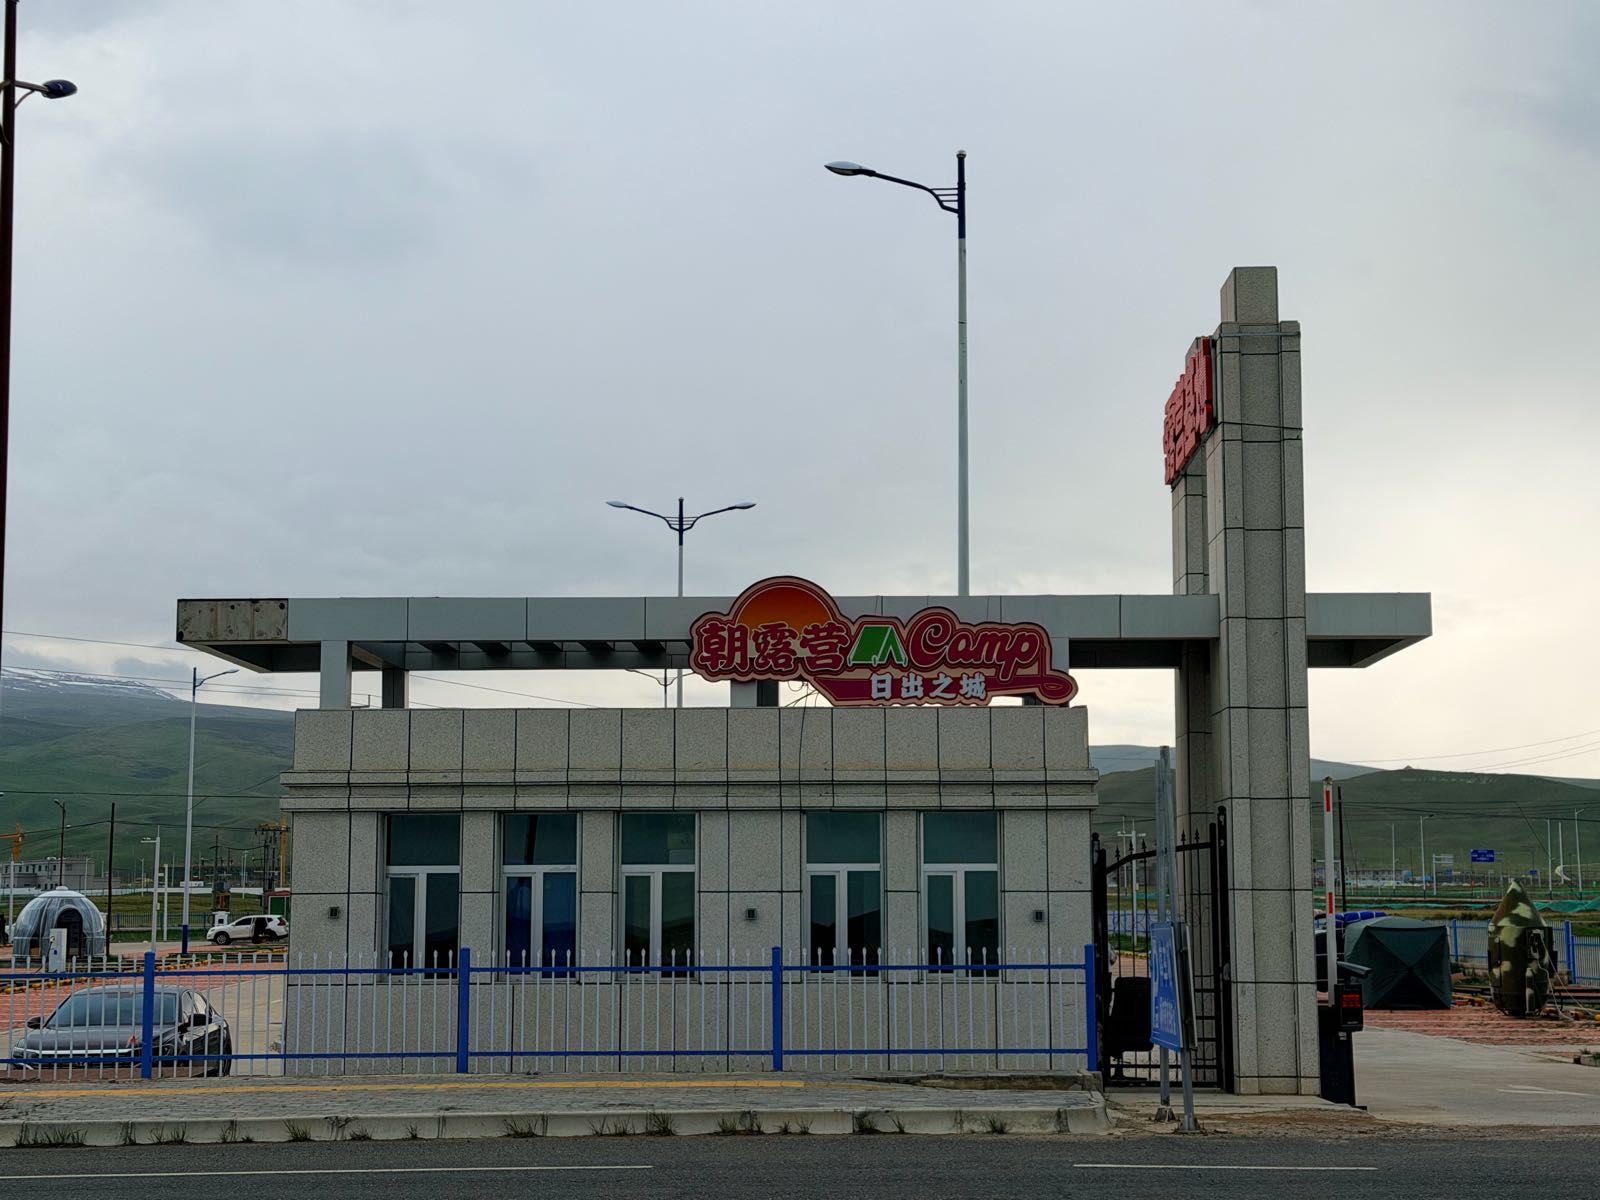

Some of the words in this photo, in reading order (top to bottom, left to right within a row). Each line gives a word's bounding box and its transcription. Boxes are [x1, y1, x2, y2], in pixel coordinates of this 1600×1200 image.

[700, 621, 850, 672] 朝露营
[910, 615, 1041, 681] Camp
[870, 673, 986, 700] 日出之城
